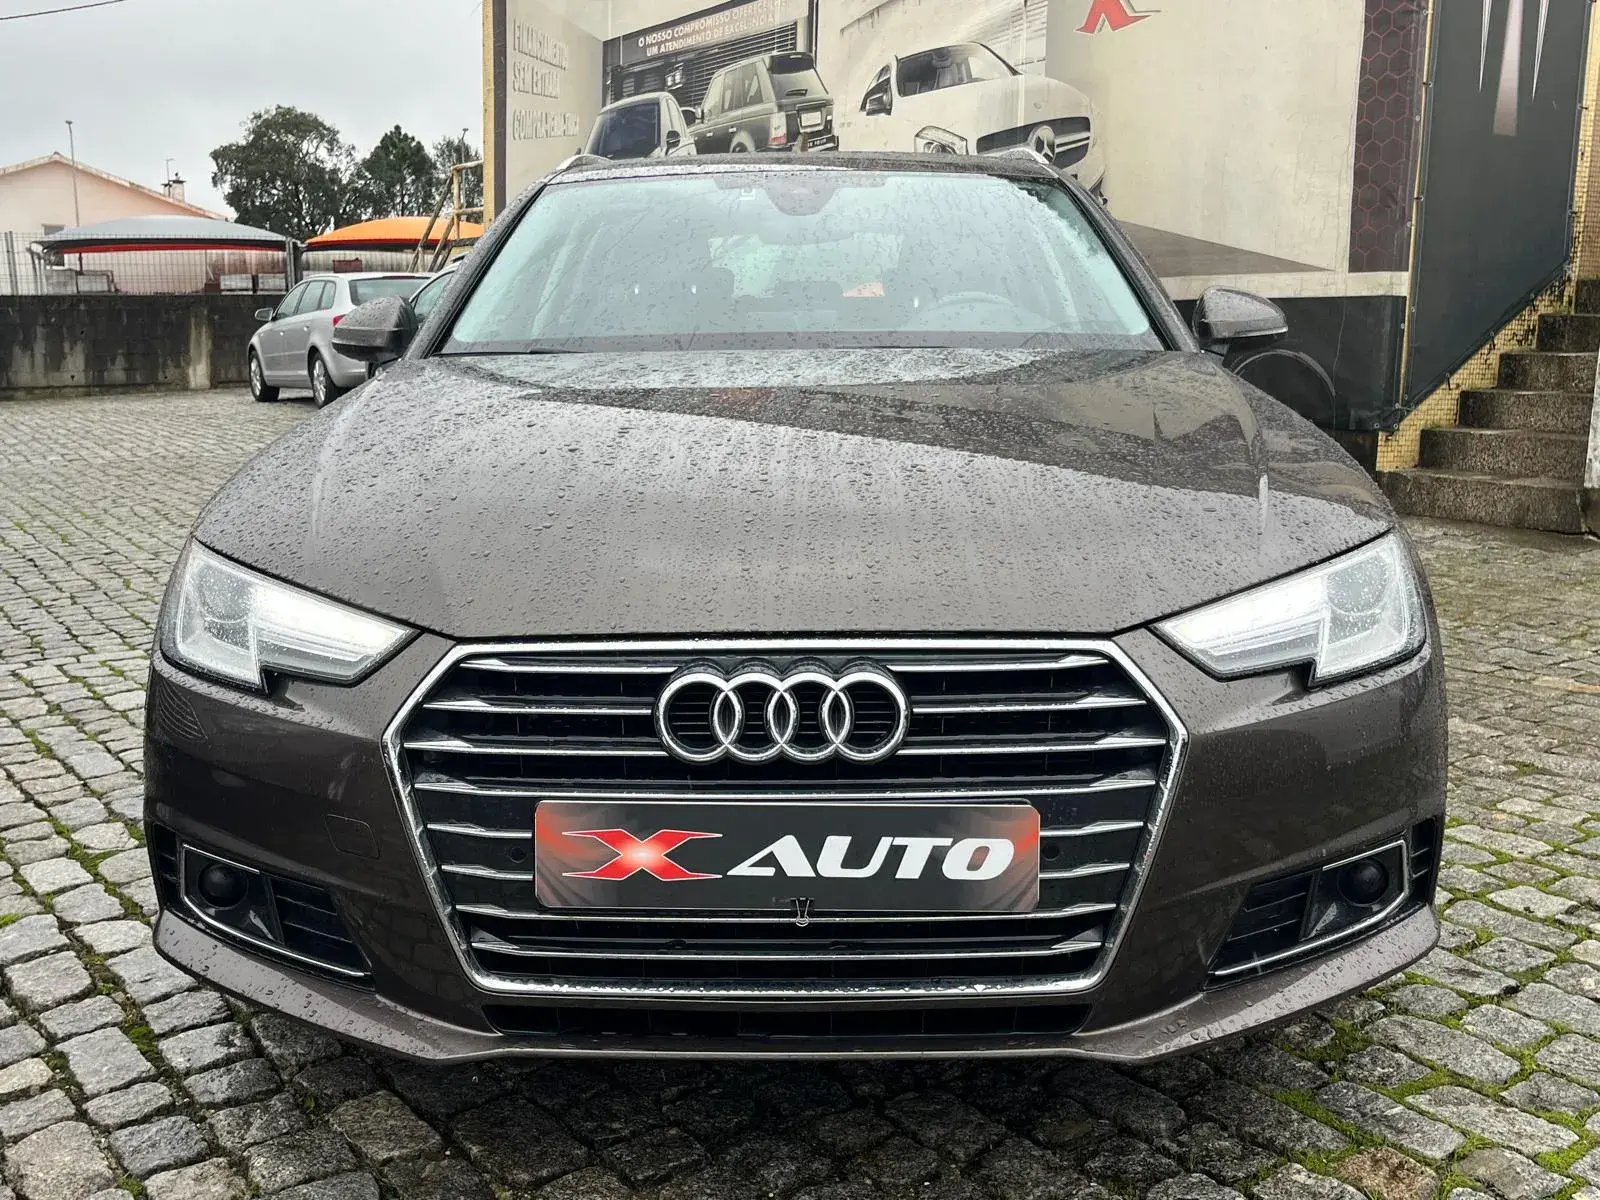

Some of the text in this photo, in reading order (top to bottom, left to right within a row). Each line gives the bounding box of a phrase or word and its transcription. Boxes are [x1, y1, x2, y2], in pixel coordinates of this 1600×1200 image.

[638, 37, 645, 47] O
[646, 29, 672, 45] NOSSO
[674, 12, 730, 38] COMPROMISSO
[646, 45, 658, 57] UM
[659, 31, 712, 54] ATENDIMENTO
[713, 27, 723, 38] DE
[561, 828, 1015, 881] X AUTO
